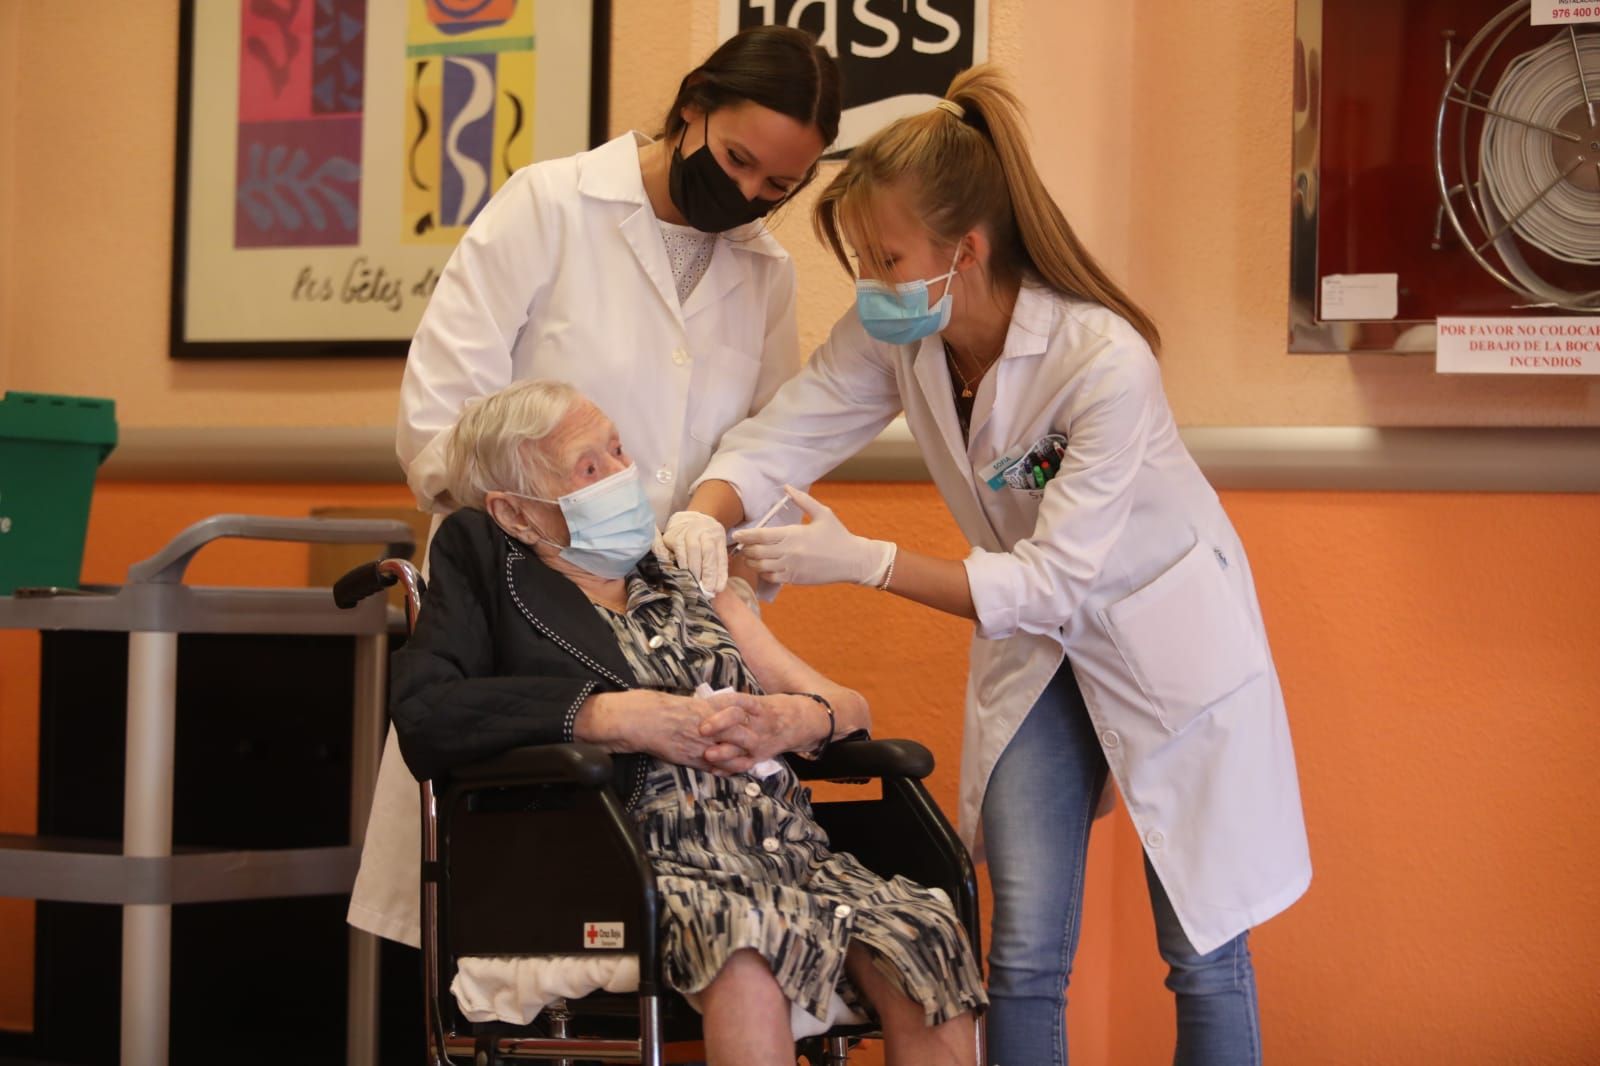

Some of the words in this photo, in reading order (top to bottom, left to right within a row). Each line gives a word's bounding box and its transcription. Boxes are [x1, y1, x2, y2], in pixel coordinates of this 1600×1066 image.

[1552, 9, 1570, 18] 976
[1573, 8, 1592, 17] 400
[1440, 325, 1466, 336] POR
[1470, 325, 1513, 336] FAVOR
[1517, 325, 1536, 336] NO
[1469, 341, 1520, 352] DEBAJO
[1524, 341, 1541, 352] DE
[1544, 341, 1562, 352] LA
[1566, 340, 1600, 352] BOCA
[1510, 356, 1582, 368] INCENDIOS
